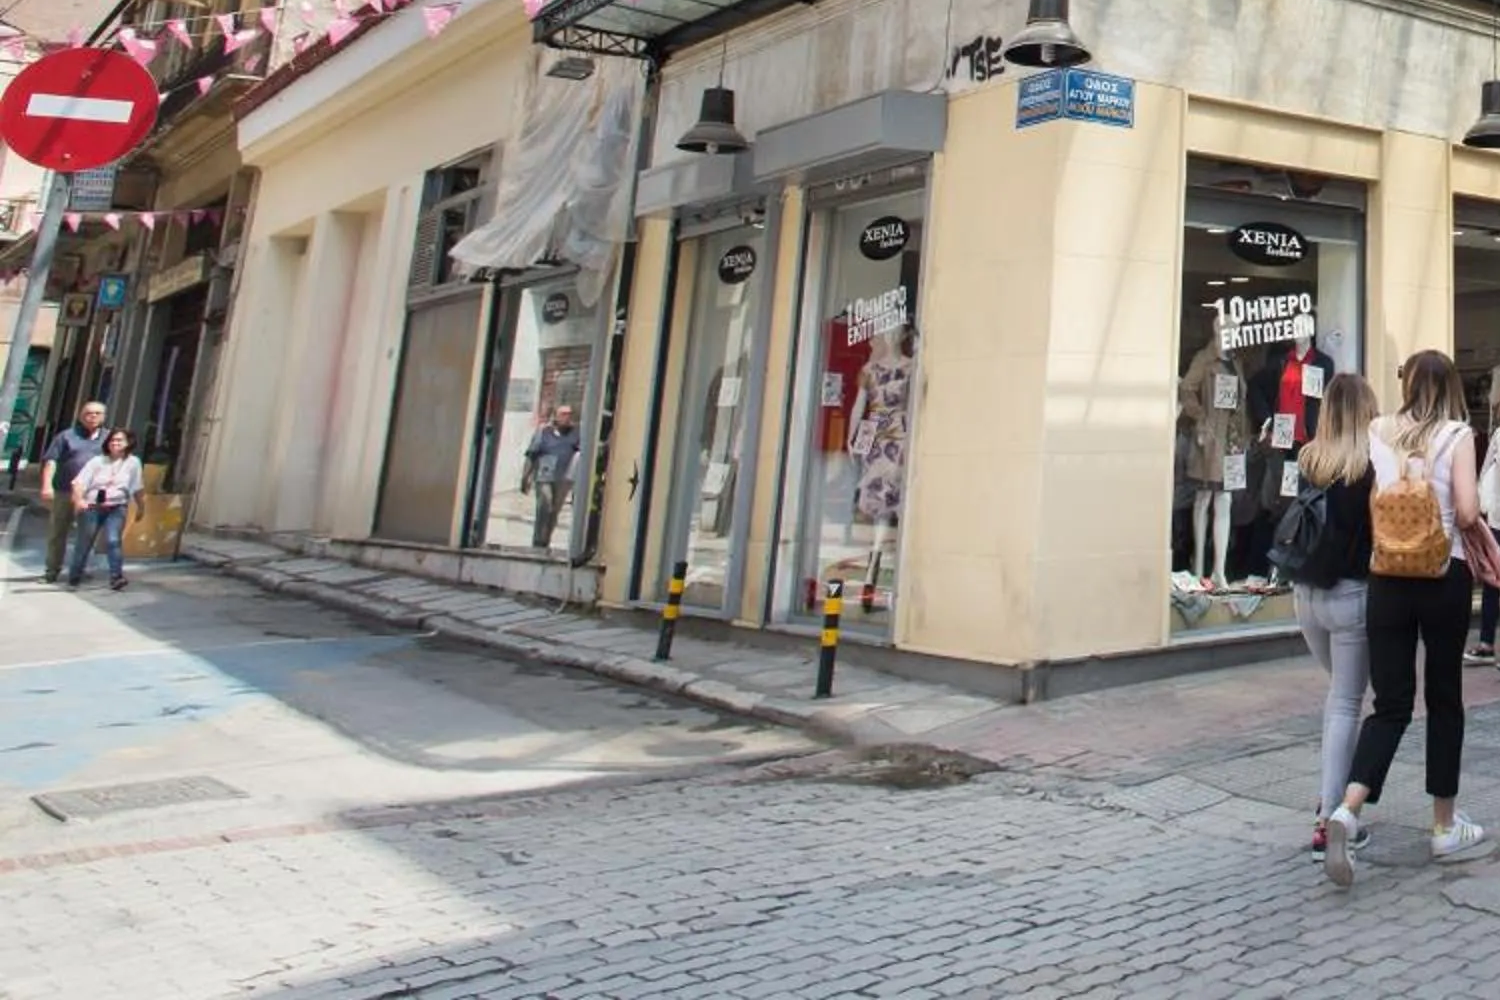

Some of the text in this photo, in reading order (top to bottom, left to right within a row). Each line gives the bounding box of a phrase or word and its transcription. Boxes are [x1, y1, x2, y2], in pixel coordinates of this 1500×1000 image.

[863, 223, 905, 242] XENIA
[1239, 229, 1302, 249] XENIA
[1220, 313, 1315, 351] ΕΚΠΤΩΣΕΩΝ
